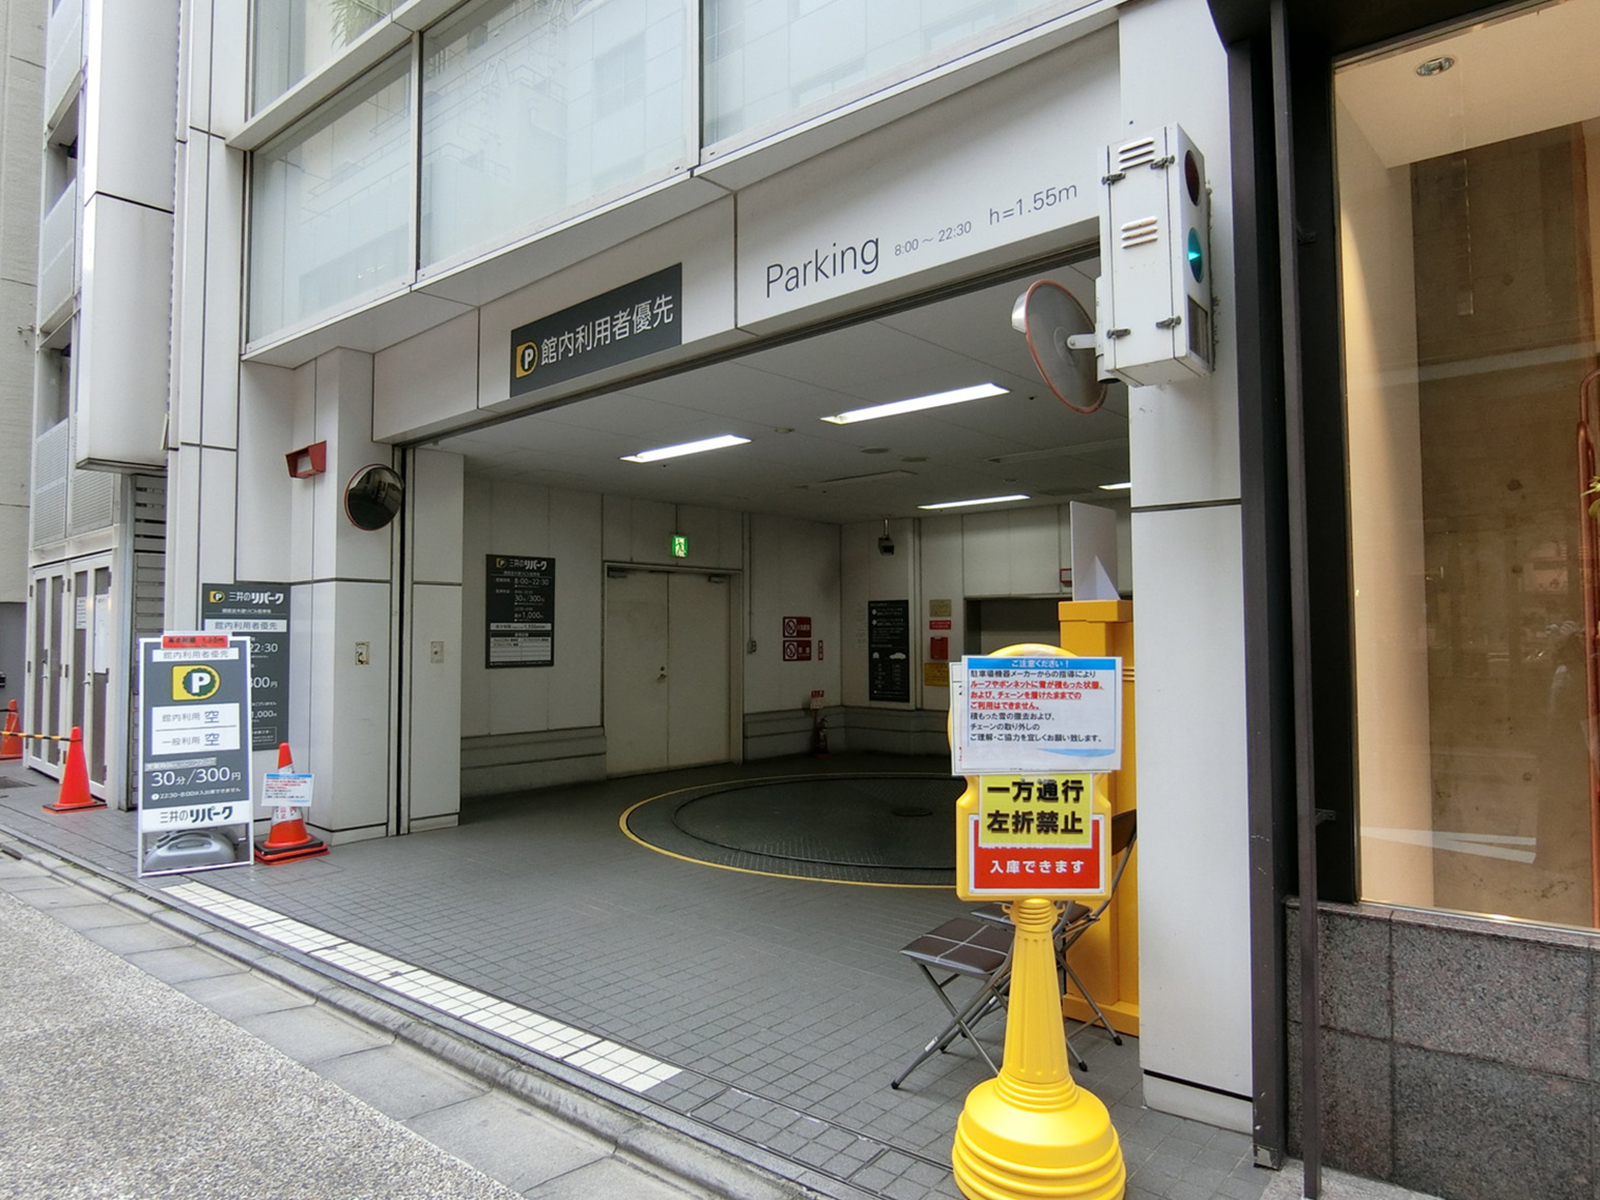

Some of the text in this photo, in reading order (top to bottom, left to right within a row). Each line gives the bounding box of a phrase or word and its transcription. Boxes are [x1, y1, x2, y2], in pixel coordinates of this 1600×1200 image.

[766, 237, 879, 299] Parking
[894, 238, 919, 257] 8:00
[938, 220, 973, 243] 22:30
[989, 184, 1078, 226] h=1.55m
[540, 294, 674, 366] 館内利用者優先
[228, 591, 285, 604] 三井のリパーク
[214, 621, 278, 631] 館内利用者優先
[163, 649, 228, 660] 館内利用者優先
[970, 669, 1097, 679] 駐車場機器メーカーからの指導により
[970, 701, 1041, 711] ご利用はできません。
[161, 710, 220, 724] 館内利用 空
[970, 723, 1041, 731] チェーンの取り外しの
[161, 733, 220, 747] 一般利用 空
[986, 779, 1085, 804] 一方通行
[160, 805, 233, 823] 三井のリパーク
[986, 809, 1084, 835] 左折禁止
[989, 859, 1085, 874] 入庫できます
